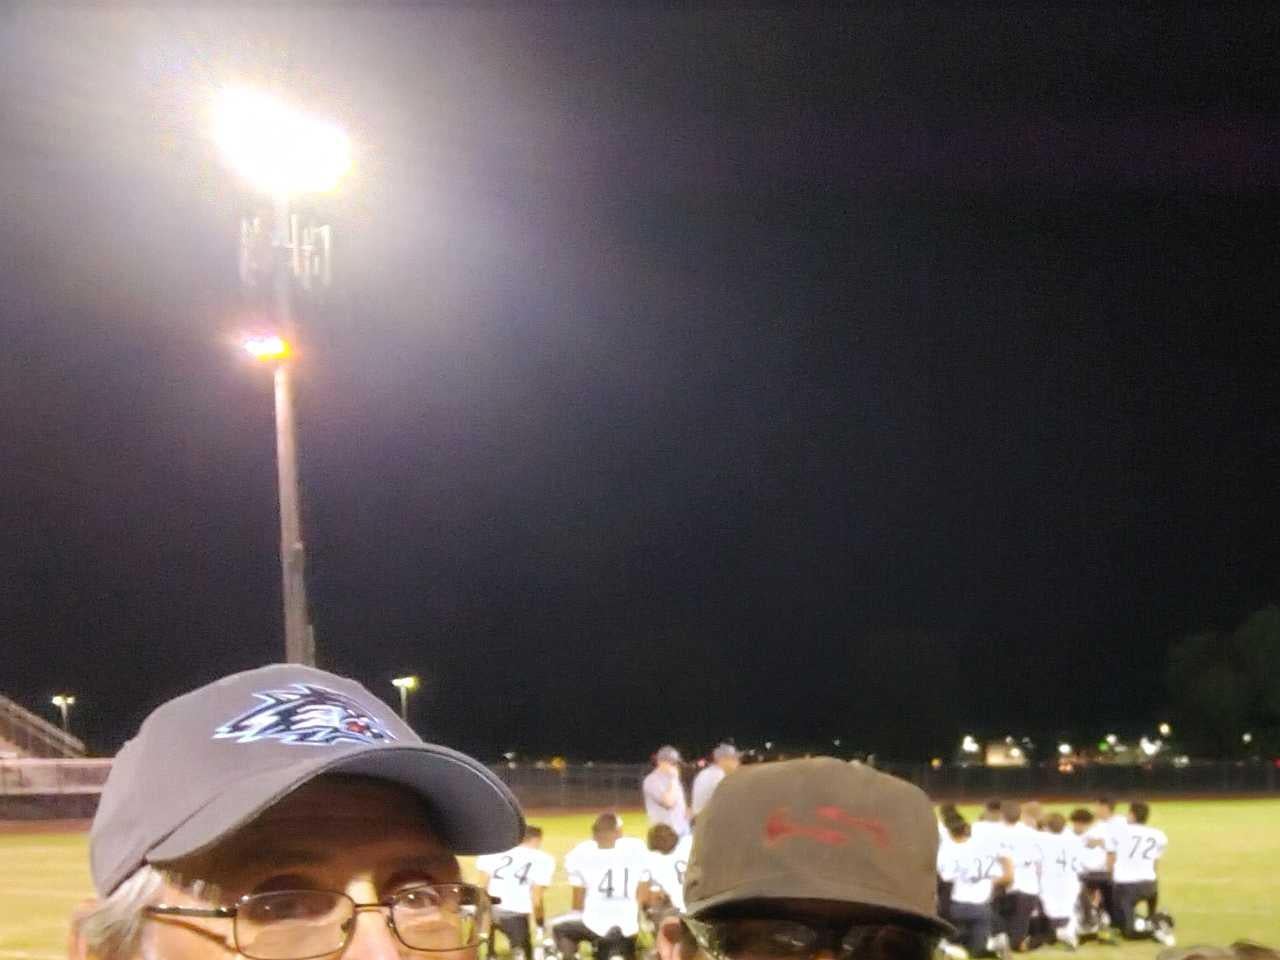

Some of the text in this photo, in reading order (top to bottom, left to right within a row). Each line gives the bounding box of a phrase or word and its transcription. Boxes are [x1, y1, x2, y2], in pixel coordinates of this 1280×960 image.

[1131, 836, 1157, 860] 72
[494, 856, 532, 885] 24
[598, 867, 629, 898] 41
